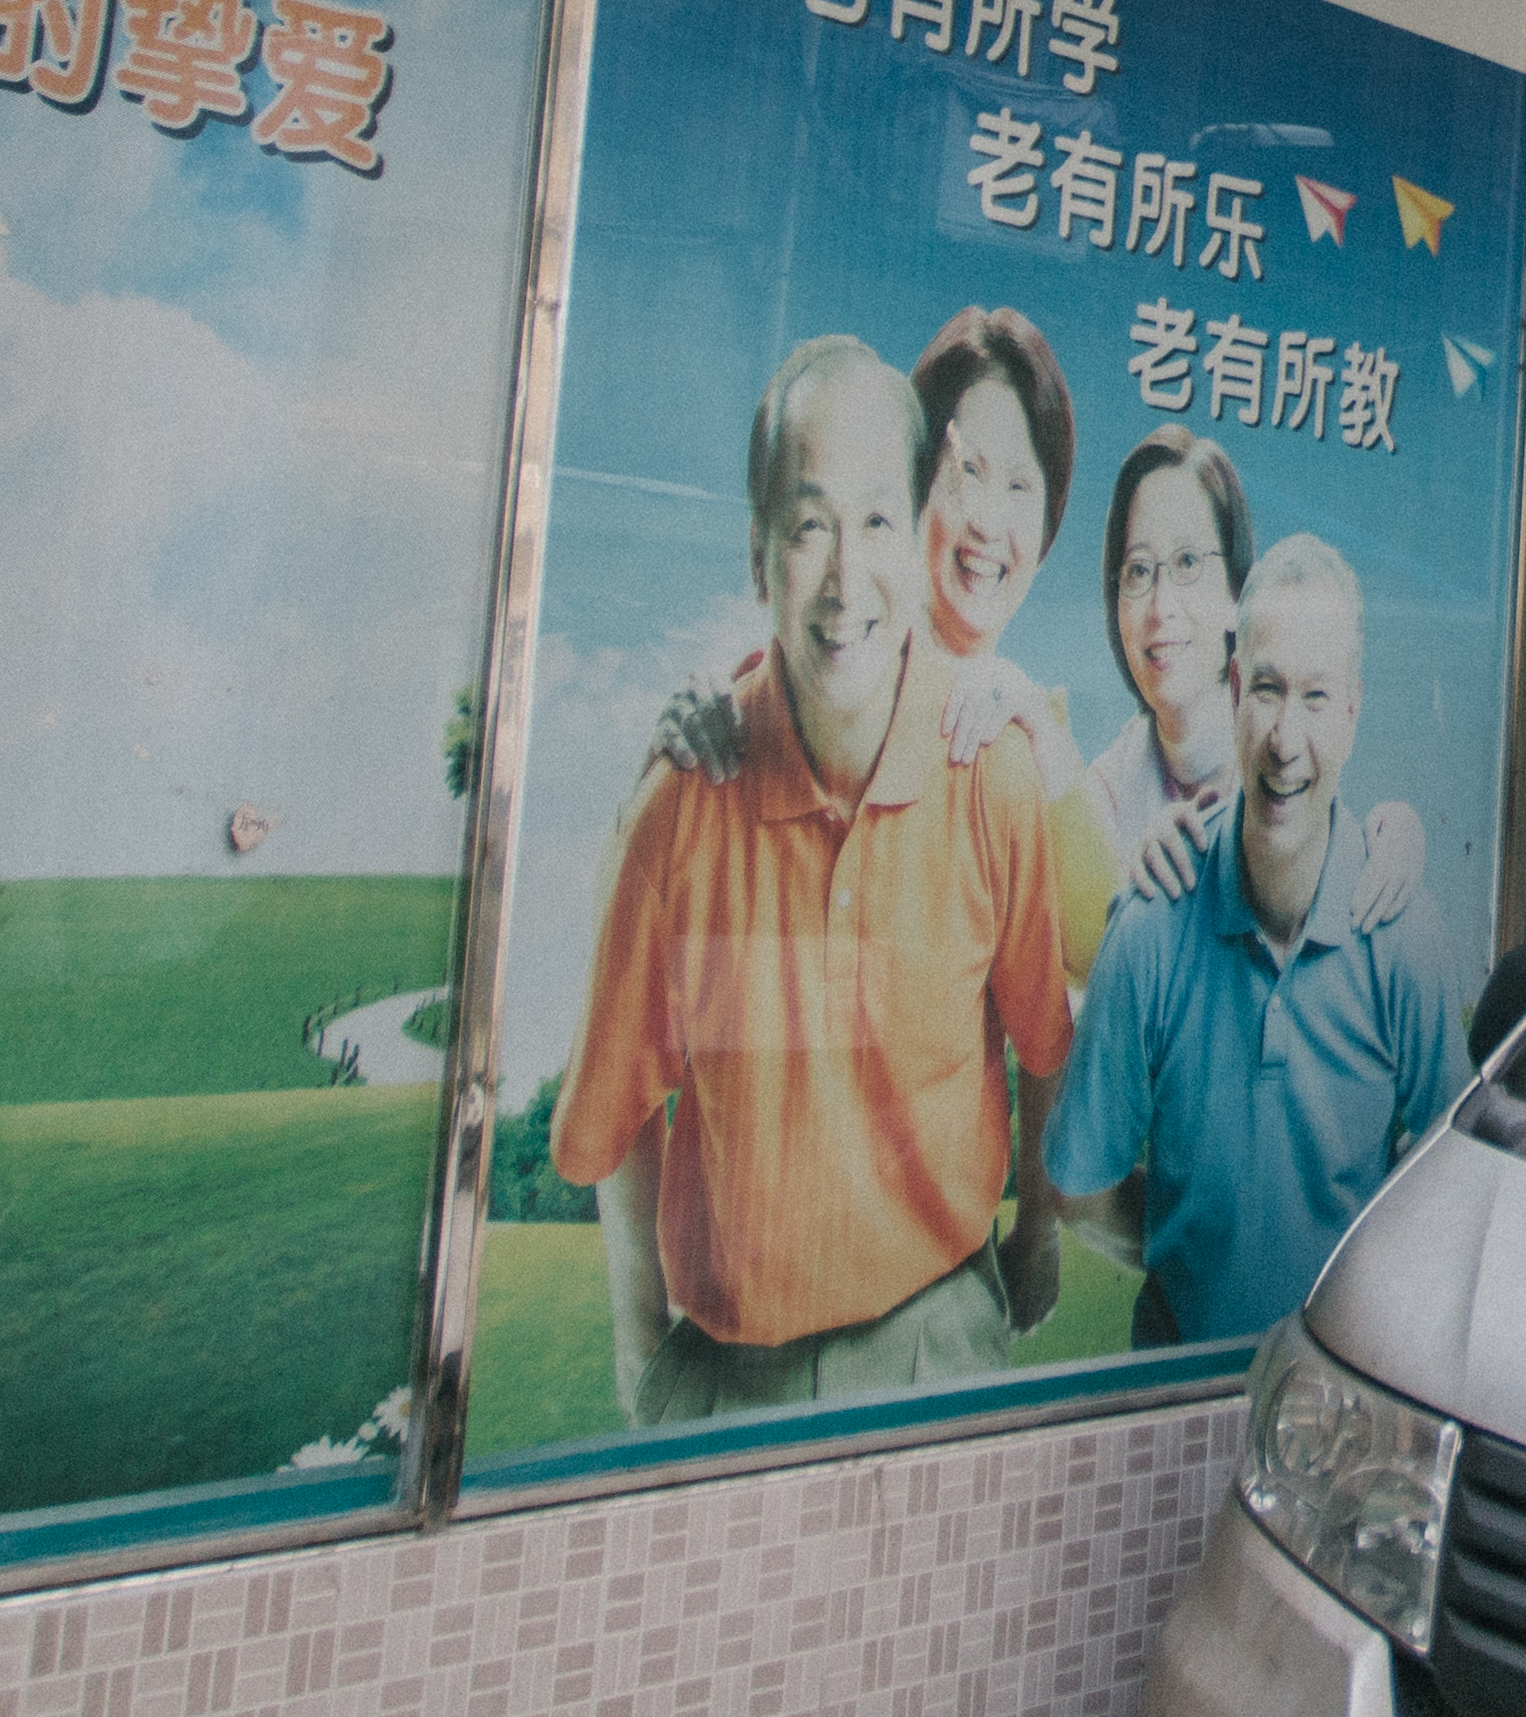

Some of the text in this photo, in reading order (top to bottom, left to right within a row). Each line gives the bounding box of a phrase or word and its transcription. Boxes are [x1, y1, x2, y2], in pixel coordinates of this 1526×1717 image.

[967, 108, 1266, 281] 老有所乐
[1128, 297, 1400, 452] 老有所教
